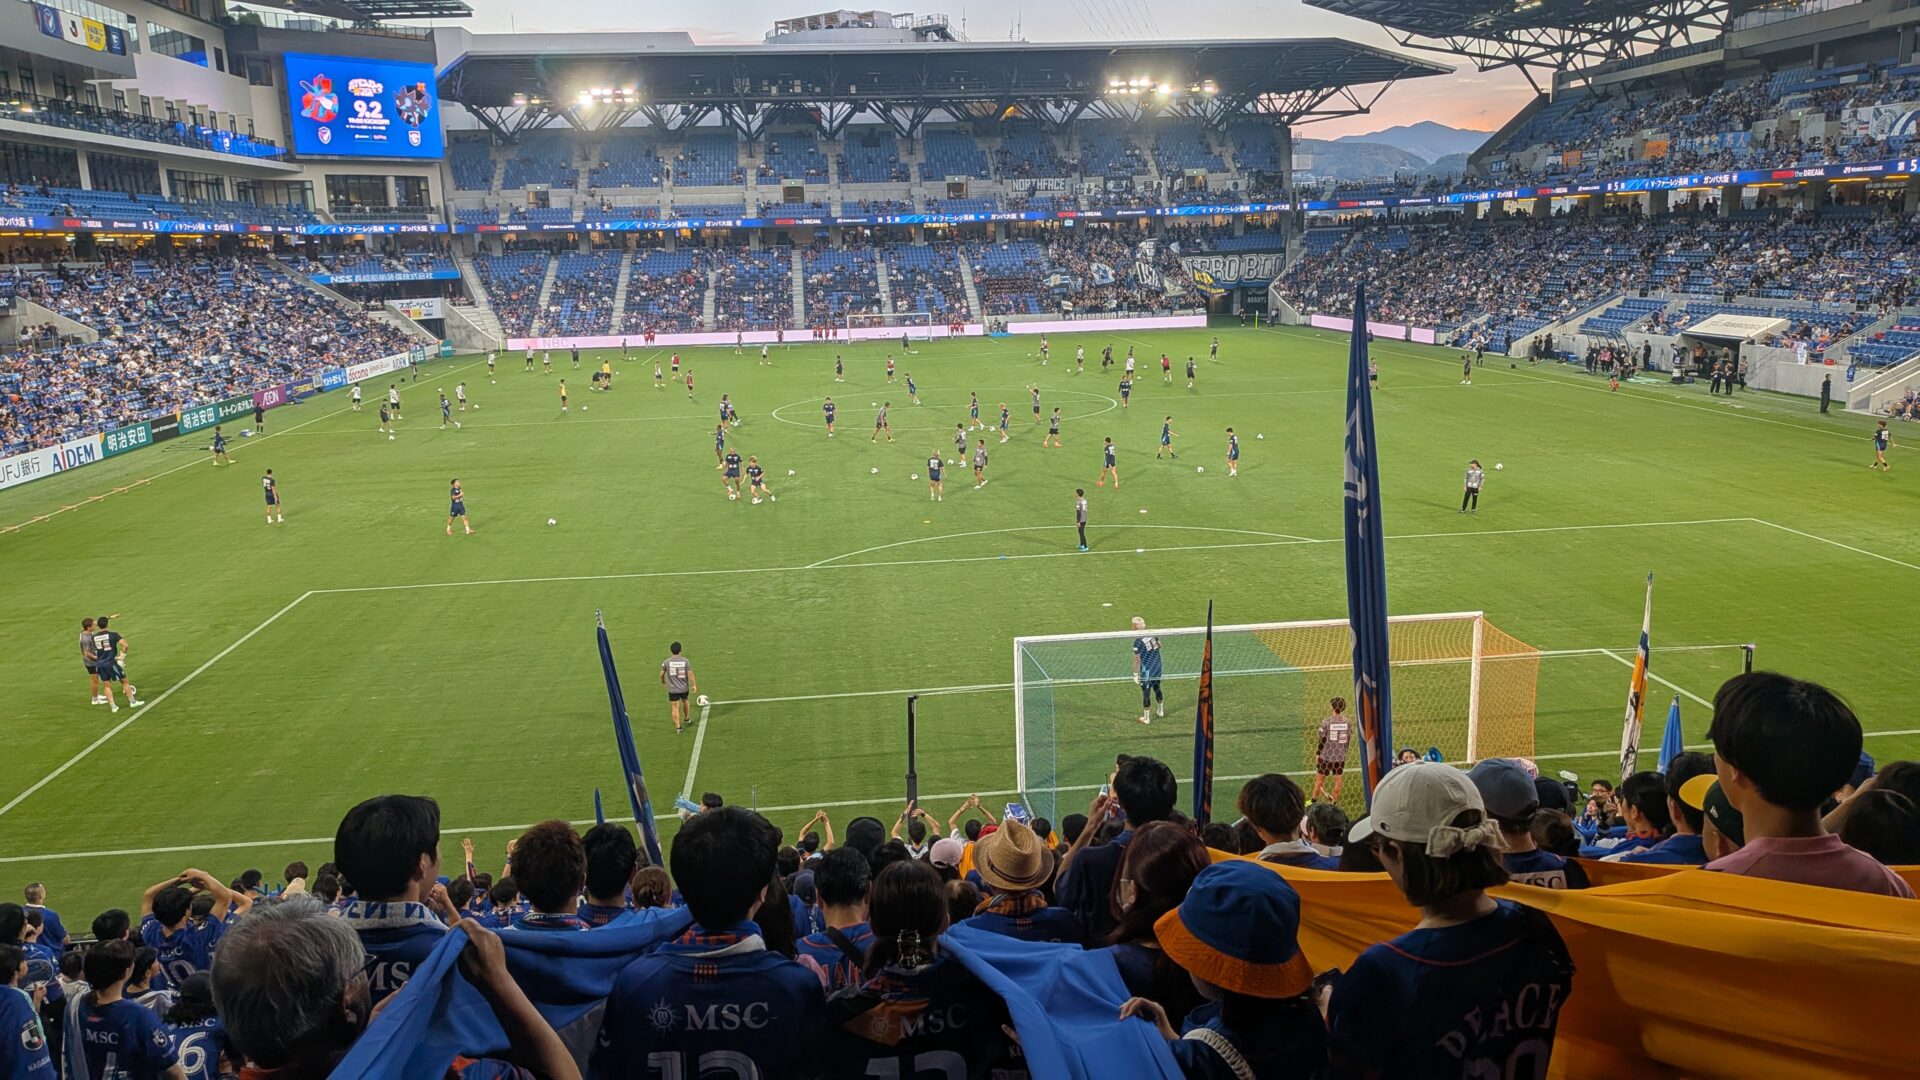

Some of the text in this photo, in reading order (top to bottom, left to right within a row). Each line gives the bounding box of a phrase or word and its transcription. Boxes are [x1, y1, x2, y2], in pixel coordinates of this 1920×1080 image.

[353, 99, 383, 118] 9.2
[1012, 177, 1066, 191] NORTHFACE
[330, 275, 353, 283] NSS
[399, 301, 433, 309] スポーツくじ
[182, 407, 215, 430] 明治安田
[107, 426, 147, 452] 明治安田
[1524, 876, 1563, 889] SC
[368, 961, 411, 991] MS
[179, 1018, 216, 1029] MSC
[684, 1001, 769, 1032] MSC
[900, 1003, 968, 1039] MSC
[85, 1028, 120, 1045] MSC
[178, 1031, 206, 1075] 6
